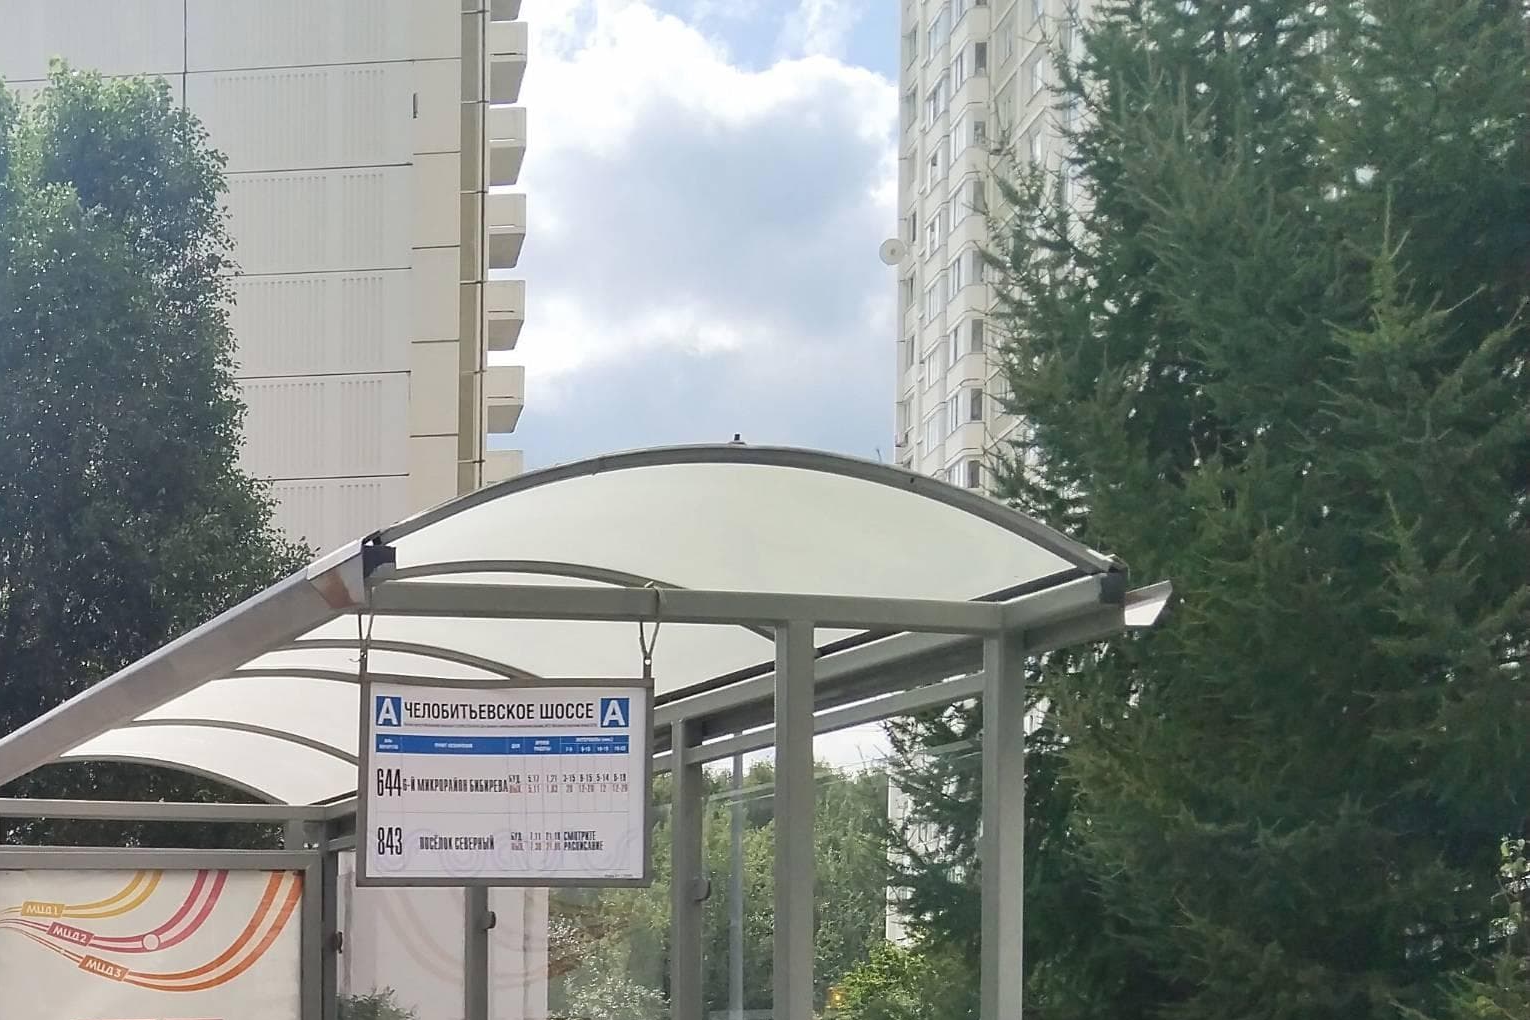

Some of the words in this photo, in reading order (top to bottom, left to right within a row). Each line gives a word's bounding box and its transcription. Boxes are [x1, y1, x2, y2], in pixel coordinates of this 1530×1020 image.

[377, 698, 398, 725] А
[404, 702, 535, 720] ЧЕЛОБИТЬЕВСКОЕ
[539, 702, 594, 719] ШОССЕ
[603, 700, 626, 725] А
[376, 768, 401, 796] 644
[417, 777, 467, 792] МИКРОРАЙОН
[470, 779, 508, 793] БИБИРЕВА
[377, 827, 402, 855] 843
